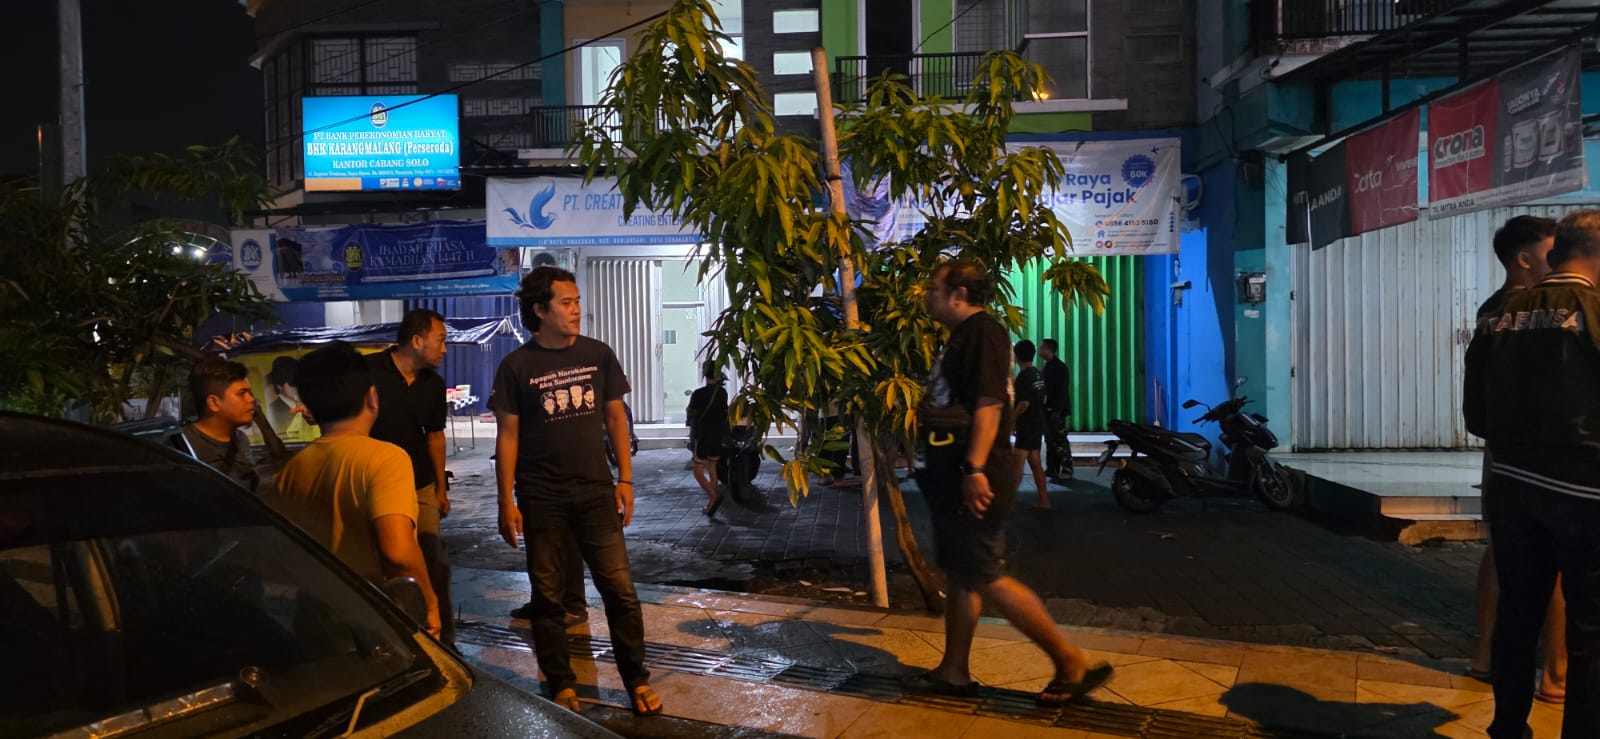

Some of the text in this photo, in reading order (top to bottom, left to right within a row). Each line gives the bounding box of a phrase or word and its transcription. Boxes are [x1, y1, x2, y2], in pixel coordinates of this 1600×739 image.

[326, 131, 348, 140] BANK
[349, 130, 413, 140] PEREKONOMIAN
[415, 129, 447, 139] RAKYAT
[307, 141, 454, 156] BKK KARANGMALANG (Perseroda)
[332, 158, 429, 169] KANTOR CABANG SOLO
[1065, 173, 1112, 189] Raya
[563, 194, 580, 211] PT.
[1081, 188, 1137, 208] Pajak
[618, 215, 656, 227] CEATING
